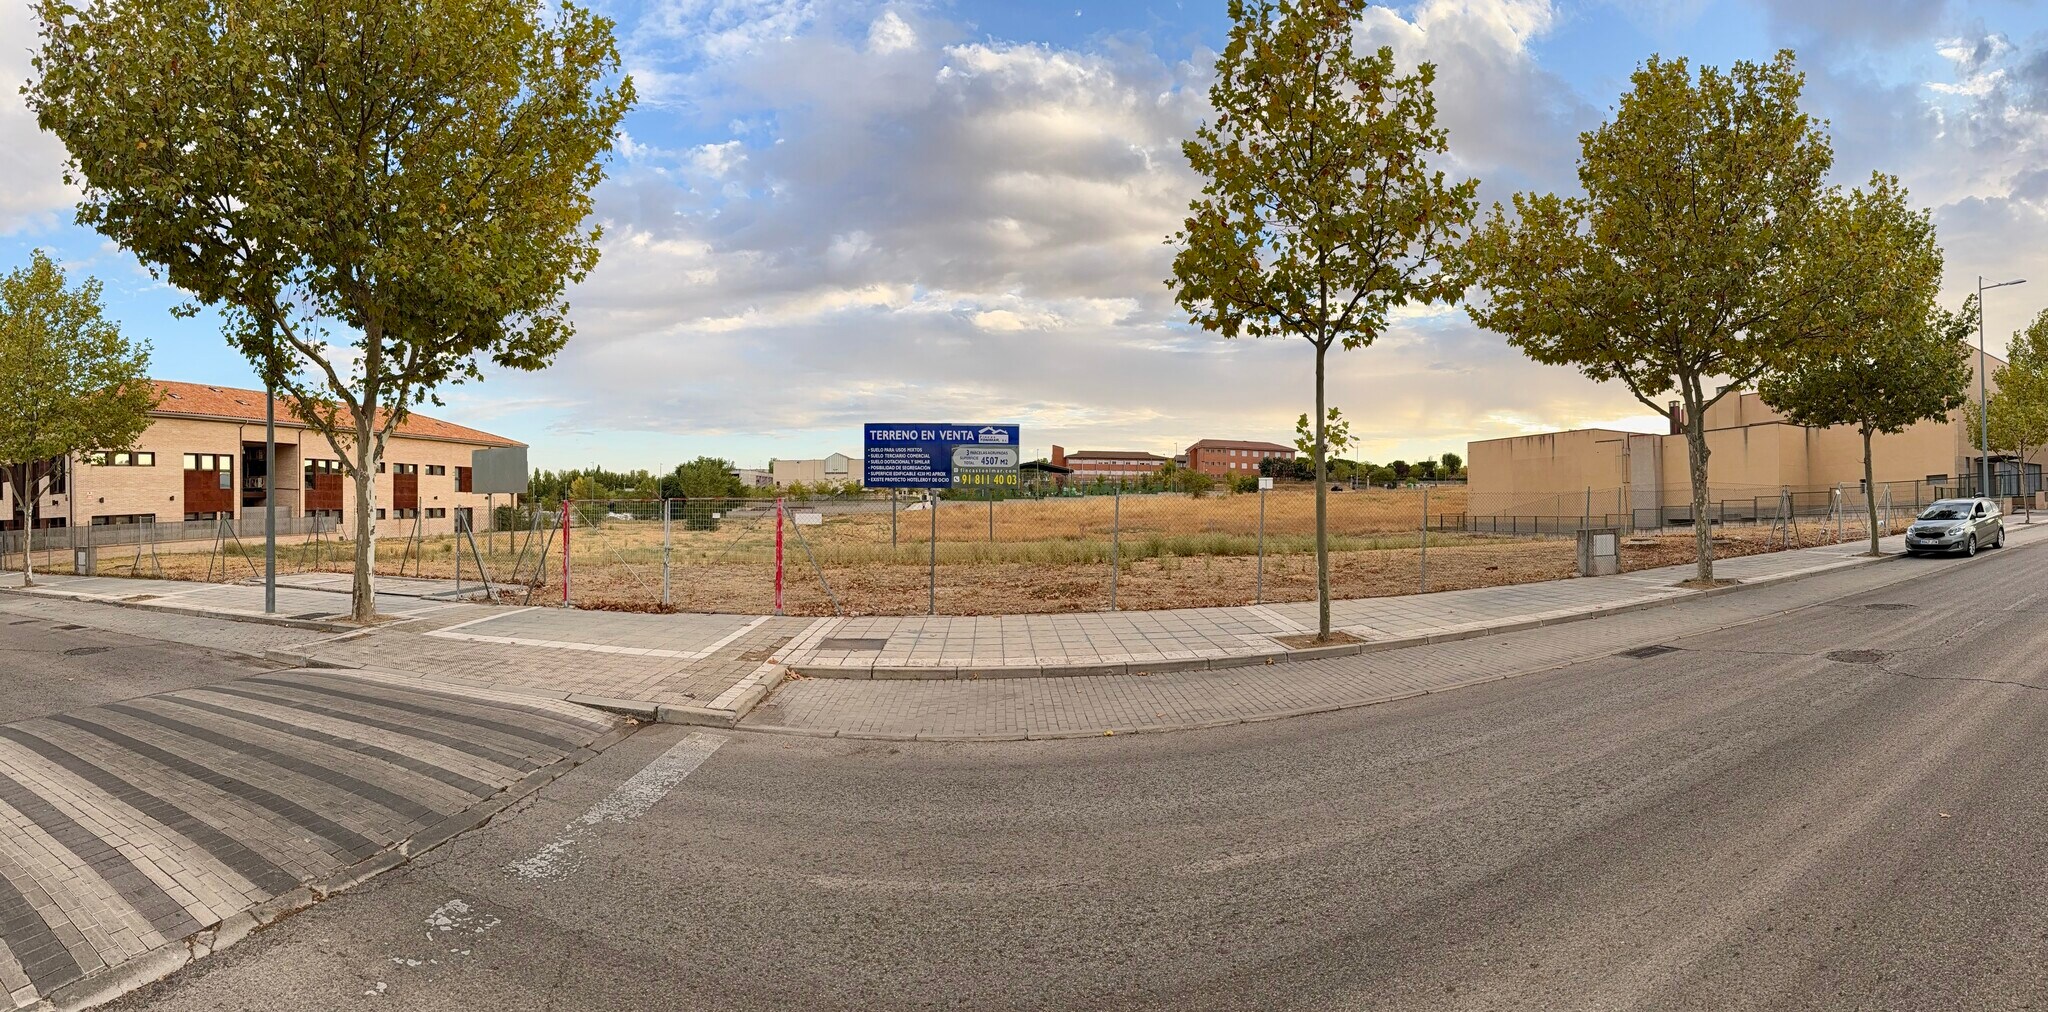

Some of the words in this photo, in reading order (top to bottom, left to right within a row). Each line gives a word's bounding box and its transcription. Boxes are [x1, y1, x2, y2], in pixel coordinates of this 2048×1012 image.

[870, 430, 918, 440] TERRENO
[921, 430, 935, 440] EN
[940, 431, 974, 440] VENTA
[981, 457, 998, 465] 4507
[962, 474, 971, 484] 91
[975, 474, 990, 484] 811
[994, 474, 1004, 484] 40
[1006, 475, 1017, 485] 03
